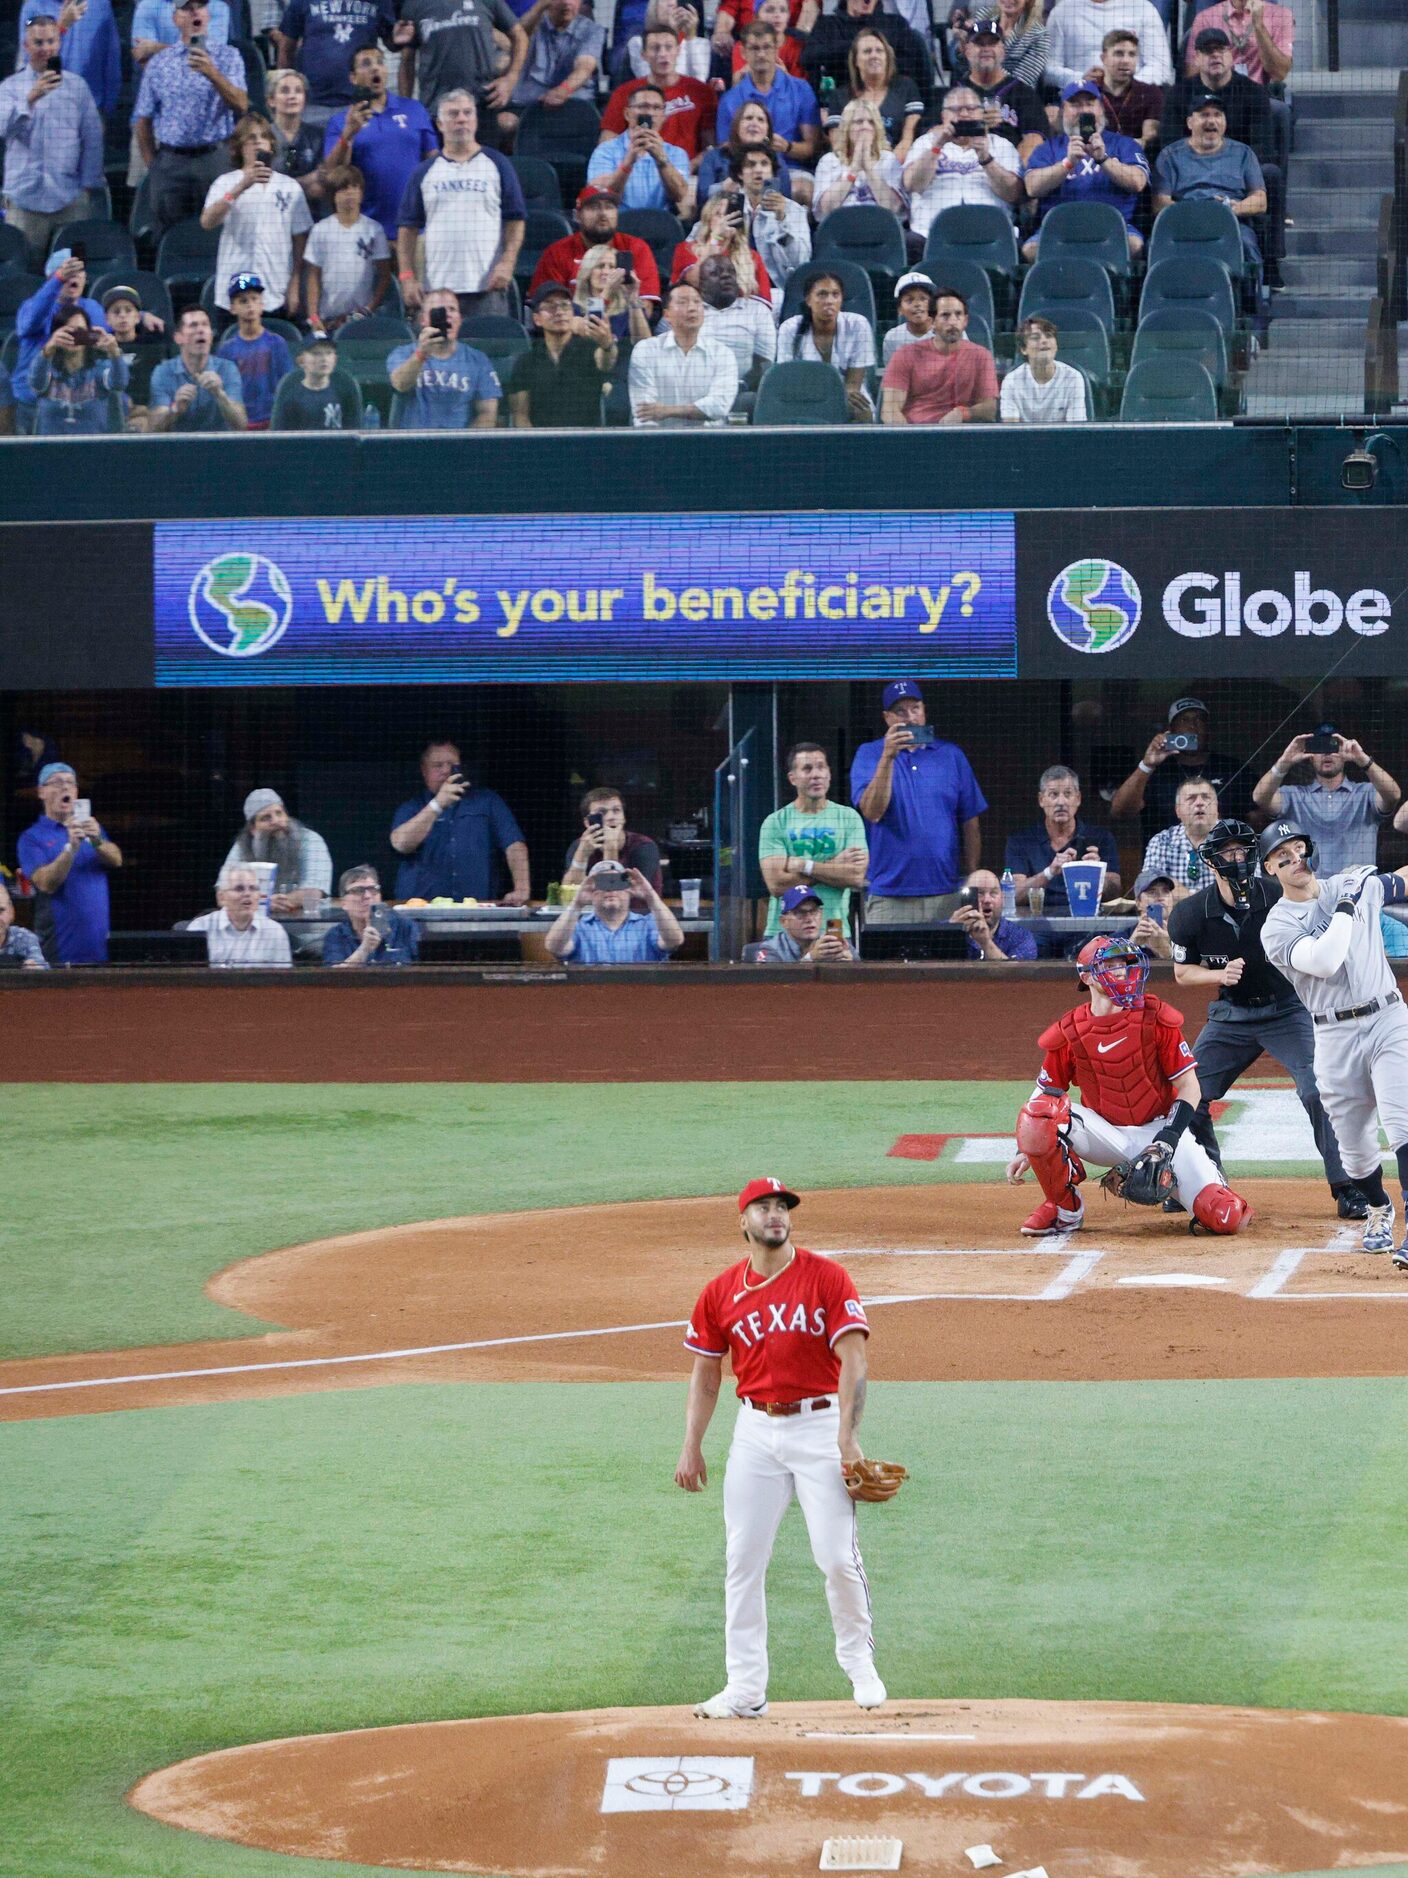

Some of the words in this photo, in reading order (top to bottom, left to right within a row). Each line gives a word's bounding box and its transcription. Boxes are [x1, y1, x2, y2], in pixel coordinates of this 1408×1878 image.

[432, 178, 488, 193] YANKEES
[324, 402, 343, 428] NY
[316, 575, 481, 624] Who's
[496, 588, 625, 638] your
[643, 569, 982, 634] beneficiary?
[1161, 570, 1392, 638] Globe
[1278, 824, 1291, 837] NY
[1074, 881, 1092, 900] T
[1209, 956, 1228, 964] FTX
[767, 1177, 783, 1191] T
[731, 1303, 827, 1348] TEXAS
[784, 1771, 1147, 1801] TOYOTA
